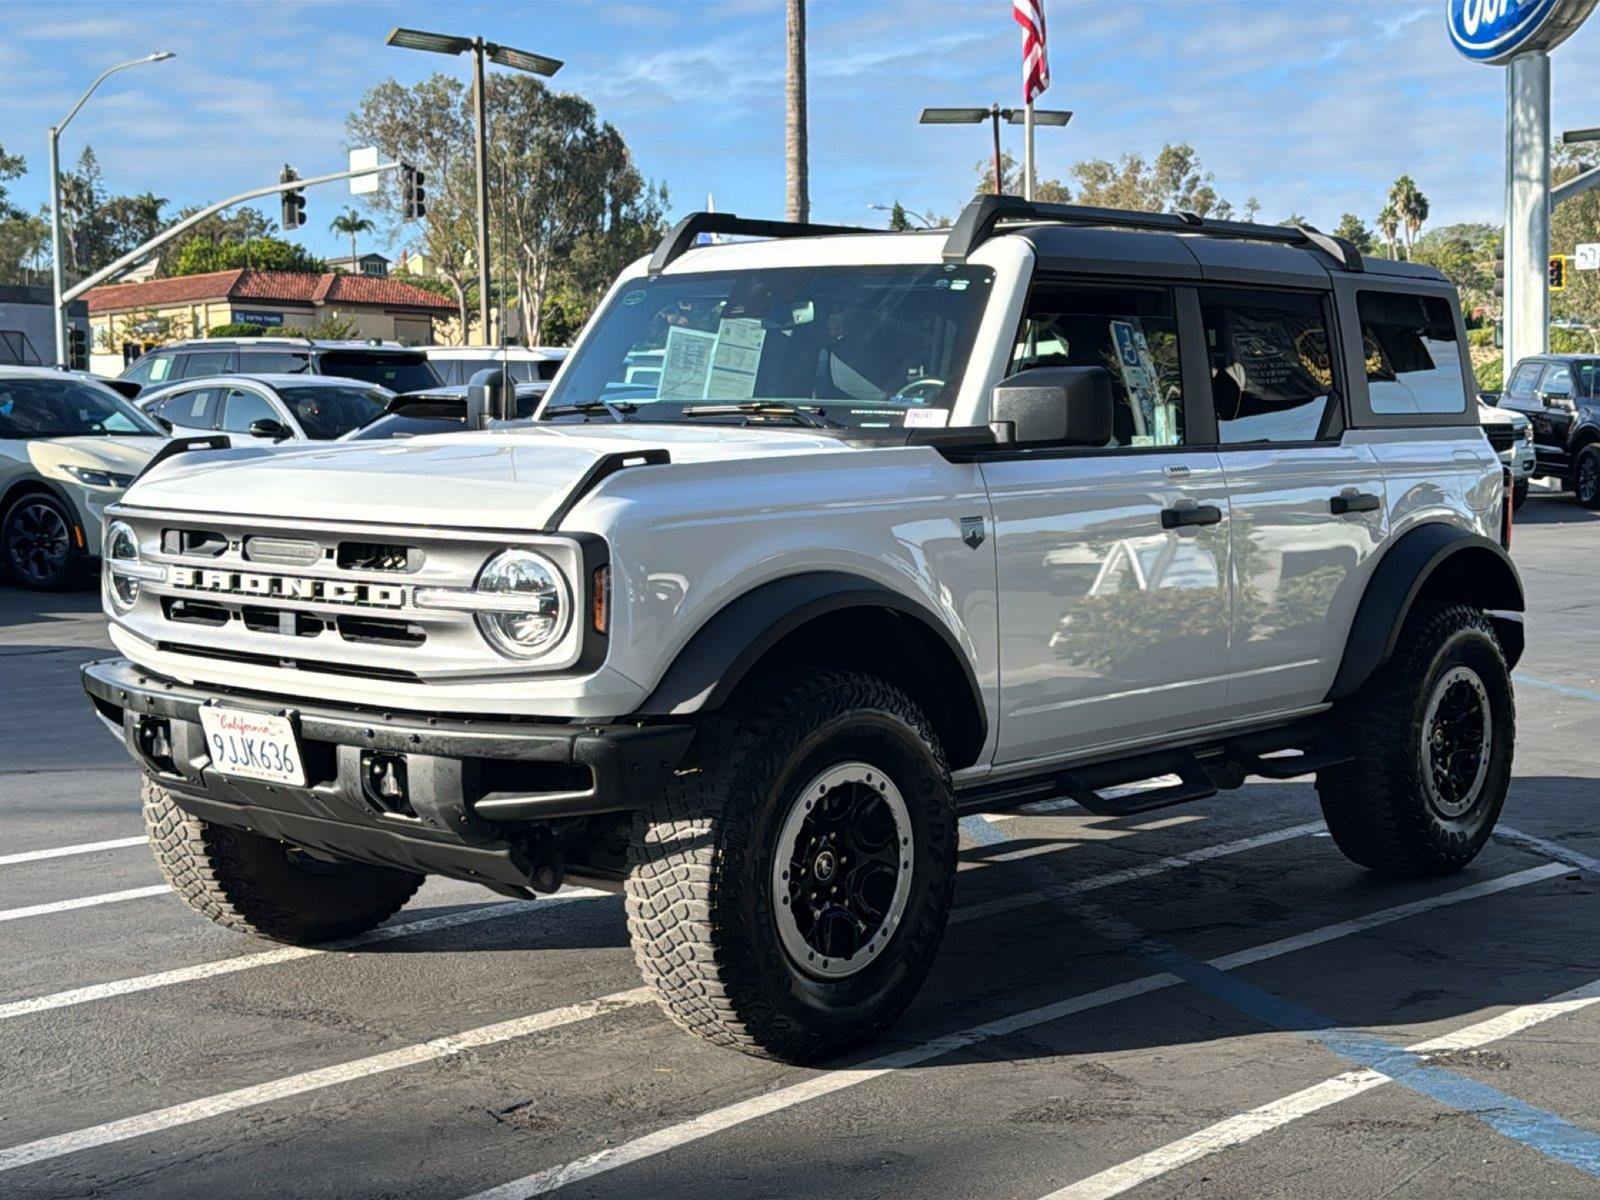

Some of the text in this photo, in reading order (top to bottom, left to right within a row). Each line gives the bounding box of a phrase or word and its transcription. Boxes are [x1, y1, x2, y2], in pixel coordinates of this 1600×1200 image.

[168, 564, 402, 607] BRONCO
[220, 714, 270, 735] California
[213, 733, 295, 773] 9JJK636
